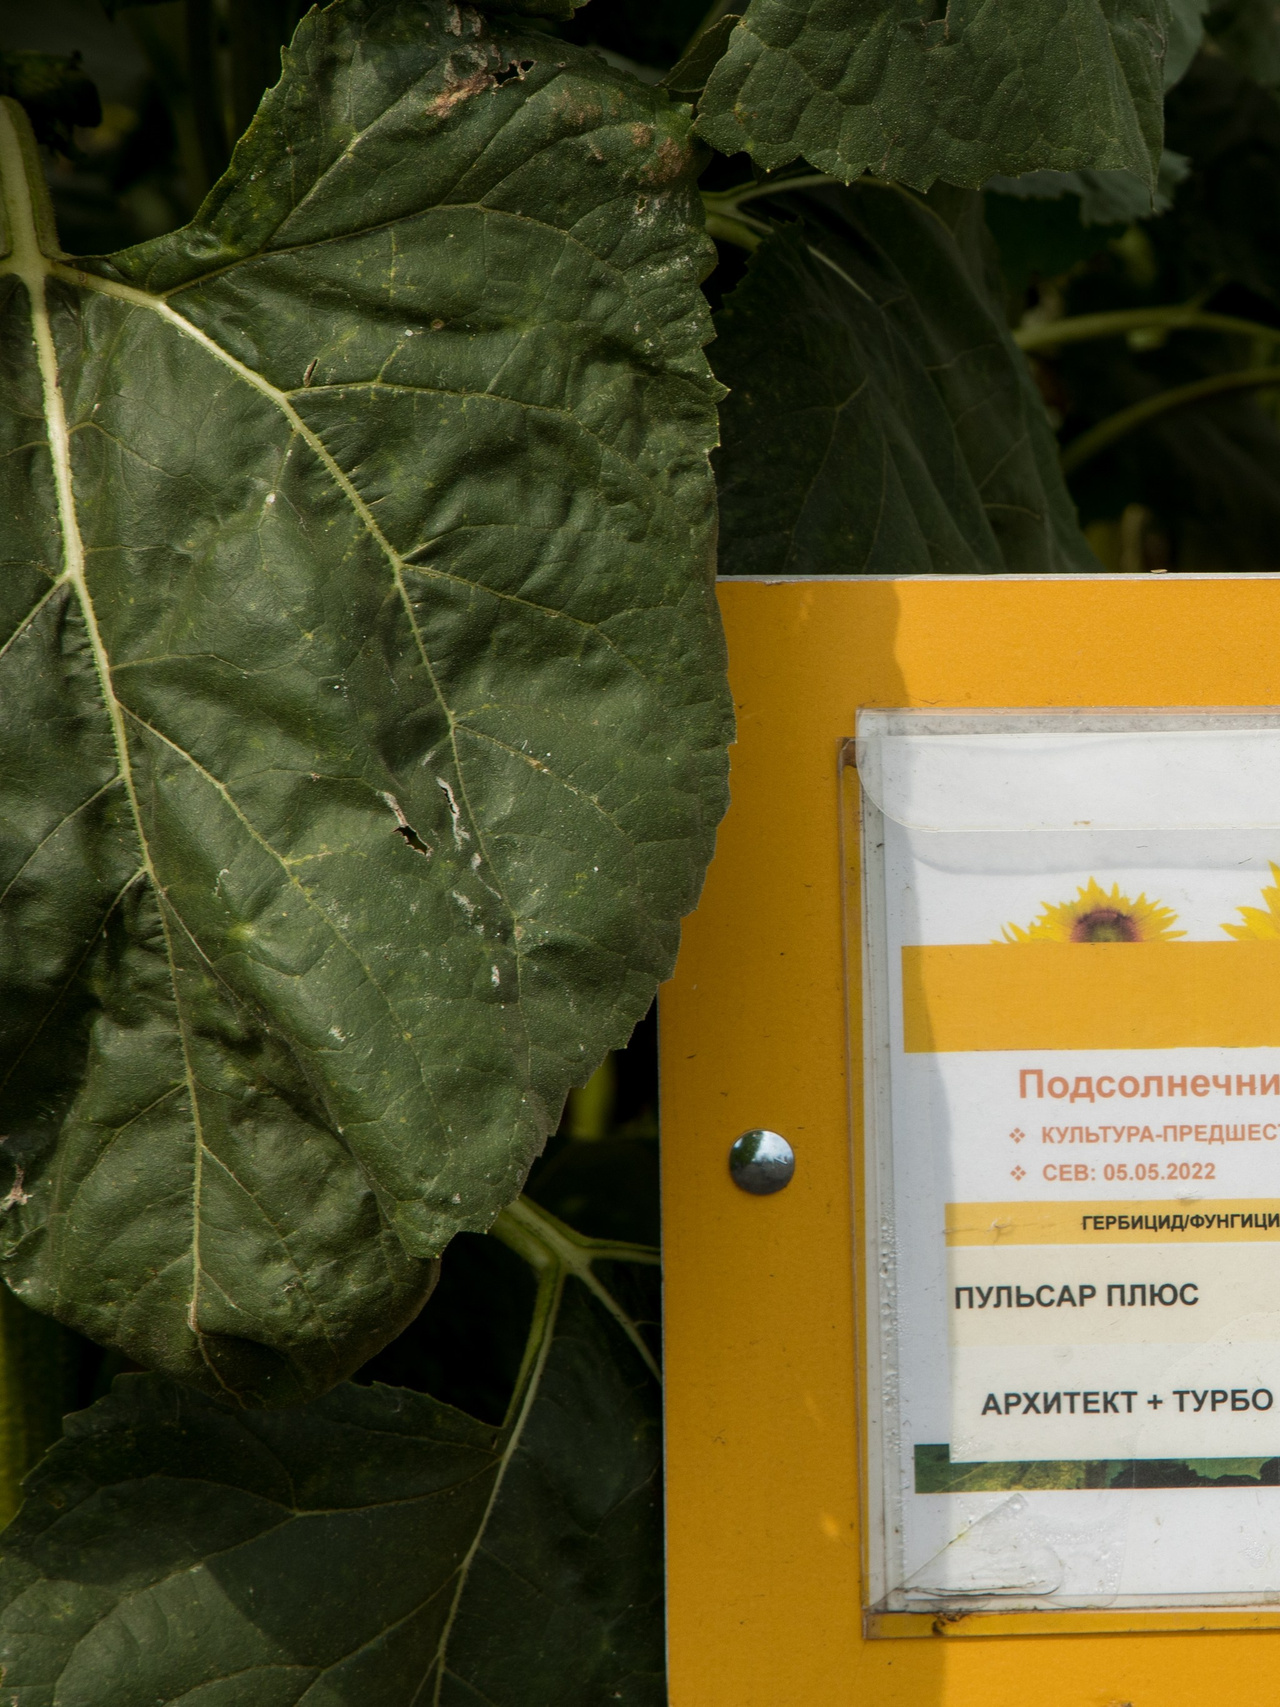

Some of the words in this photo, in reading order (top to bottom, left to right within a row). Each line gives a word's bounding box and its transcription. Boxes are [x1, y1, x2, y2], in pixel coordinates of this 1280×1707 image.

[1042, 1163, 1096, 1183] СЕВ:
[1103, 1162, 1216, 1182] 05.05.2022
[954, 1284, 1097, 1310] ПУЛЬСАР
[1107, 1283, 1199, 1307] ПЛЮС
[981, 1391, 1138, 1416] АРХИТЕКТ
[1147, 1394, 1163, 1410] +
[1172, 1388, 1274, 1413] ТУРБО
